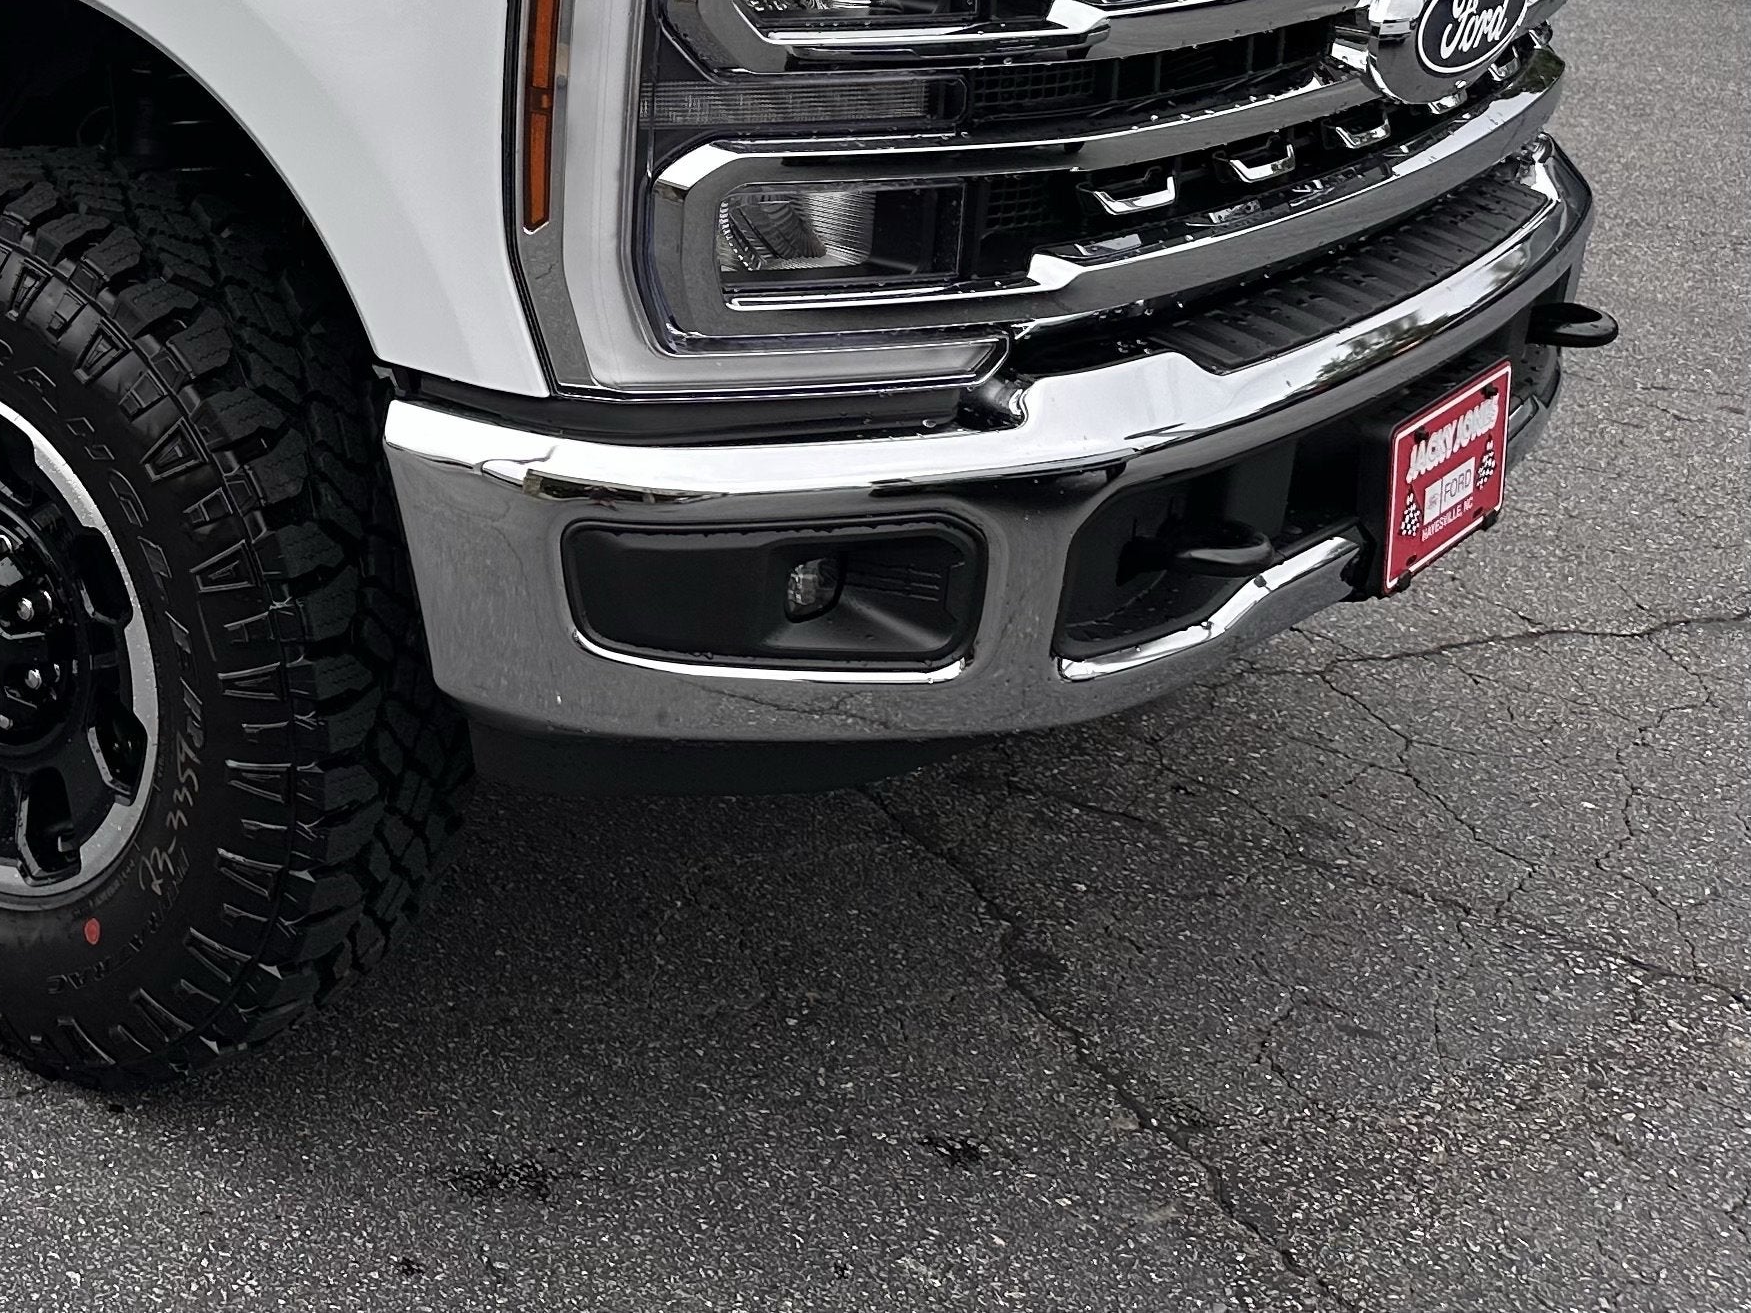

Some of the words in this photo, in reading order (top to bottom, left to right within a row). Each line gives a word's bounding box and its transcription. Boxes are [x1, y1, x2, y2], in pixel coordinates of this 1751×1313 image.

[1406, 419, 1458, 484] JACKY
[1452, 392, 1500, 453] JONES
[1443, 468, 1472, 503] FORD
[1463, 496, 1474, 513] NC
